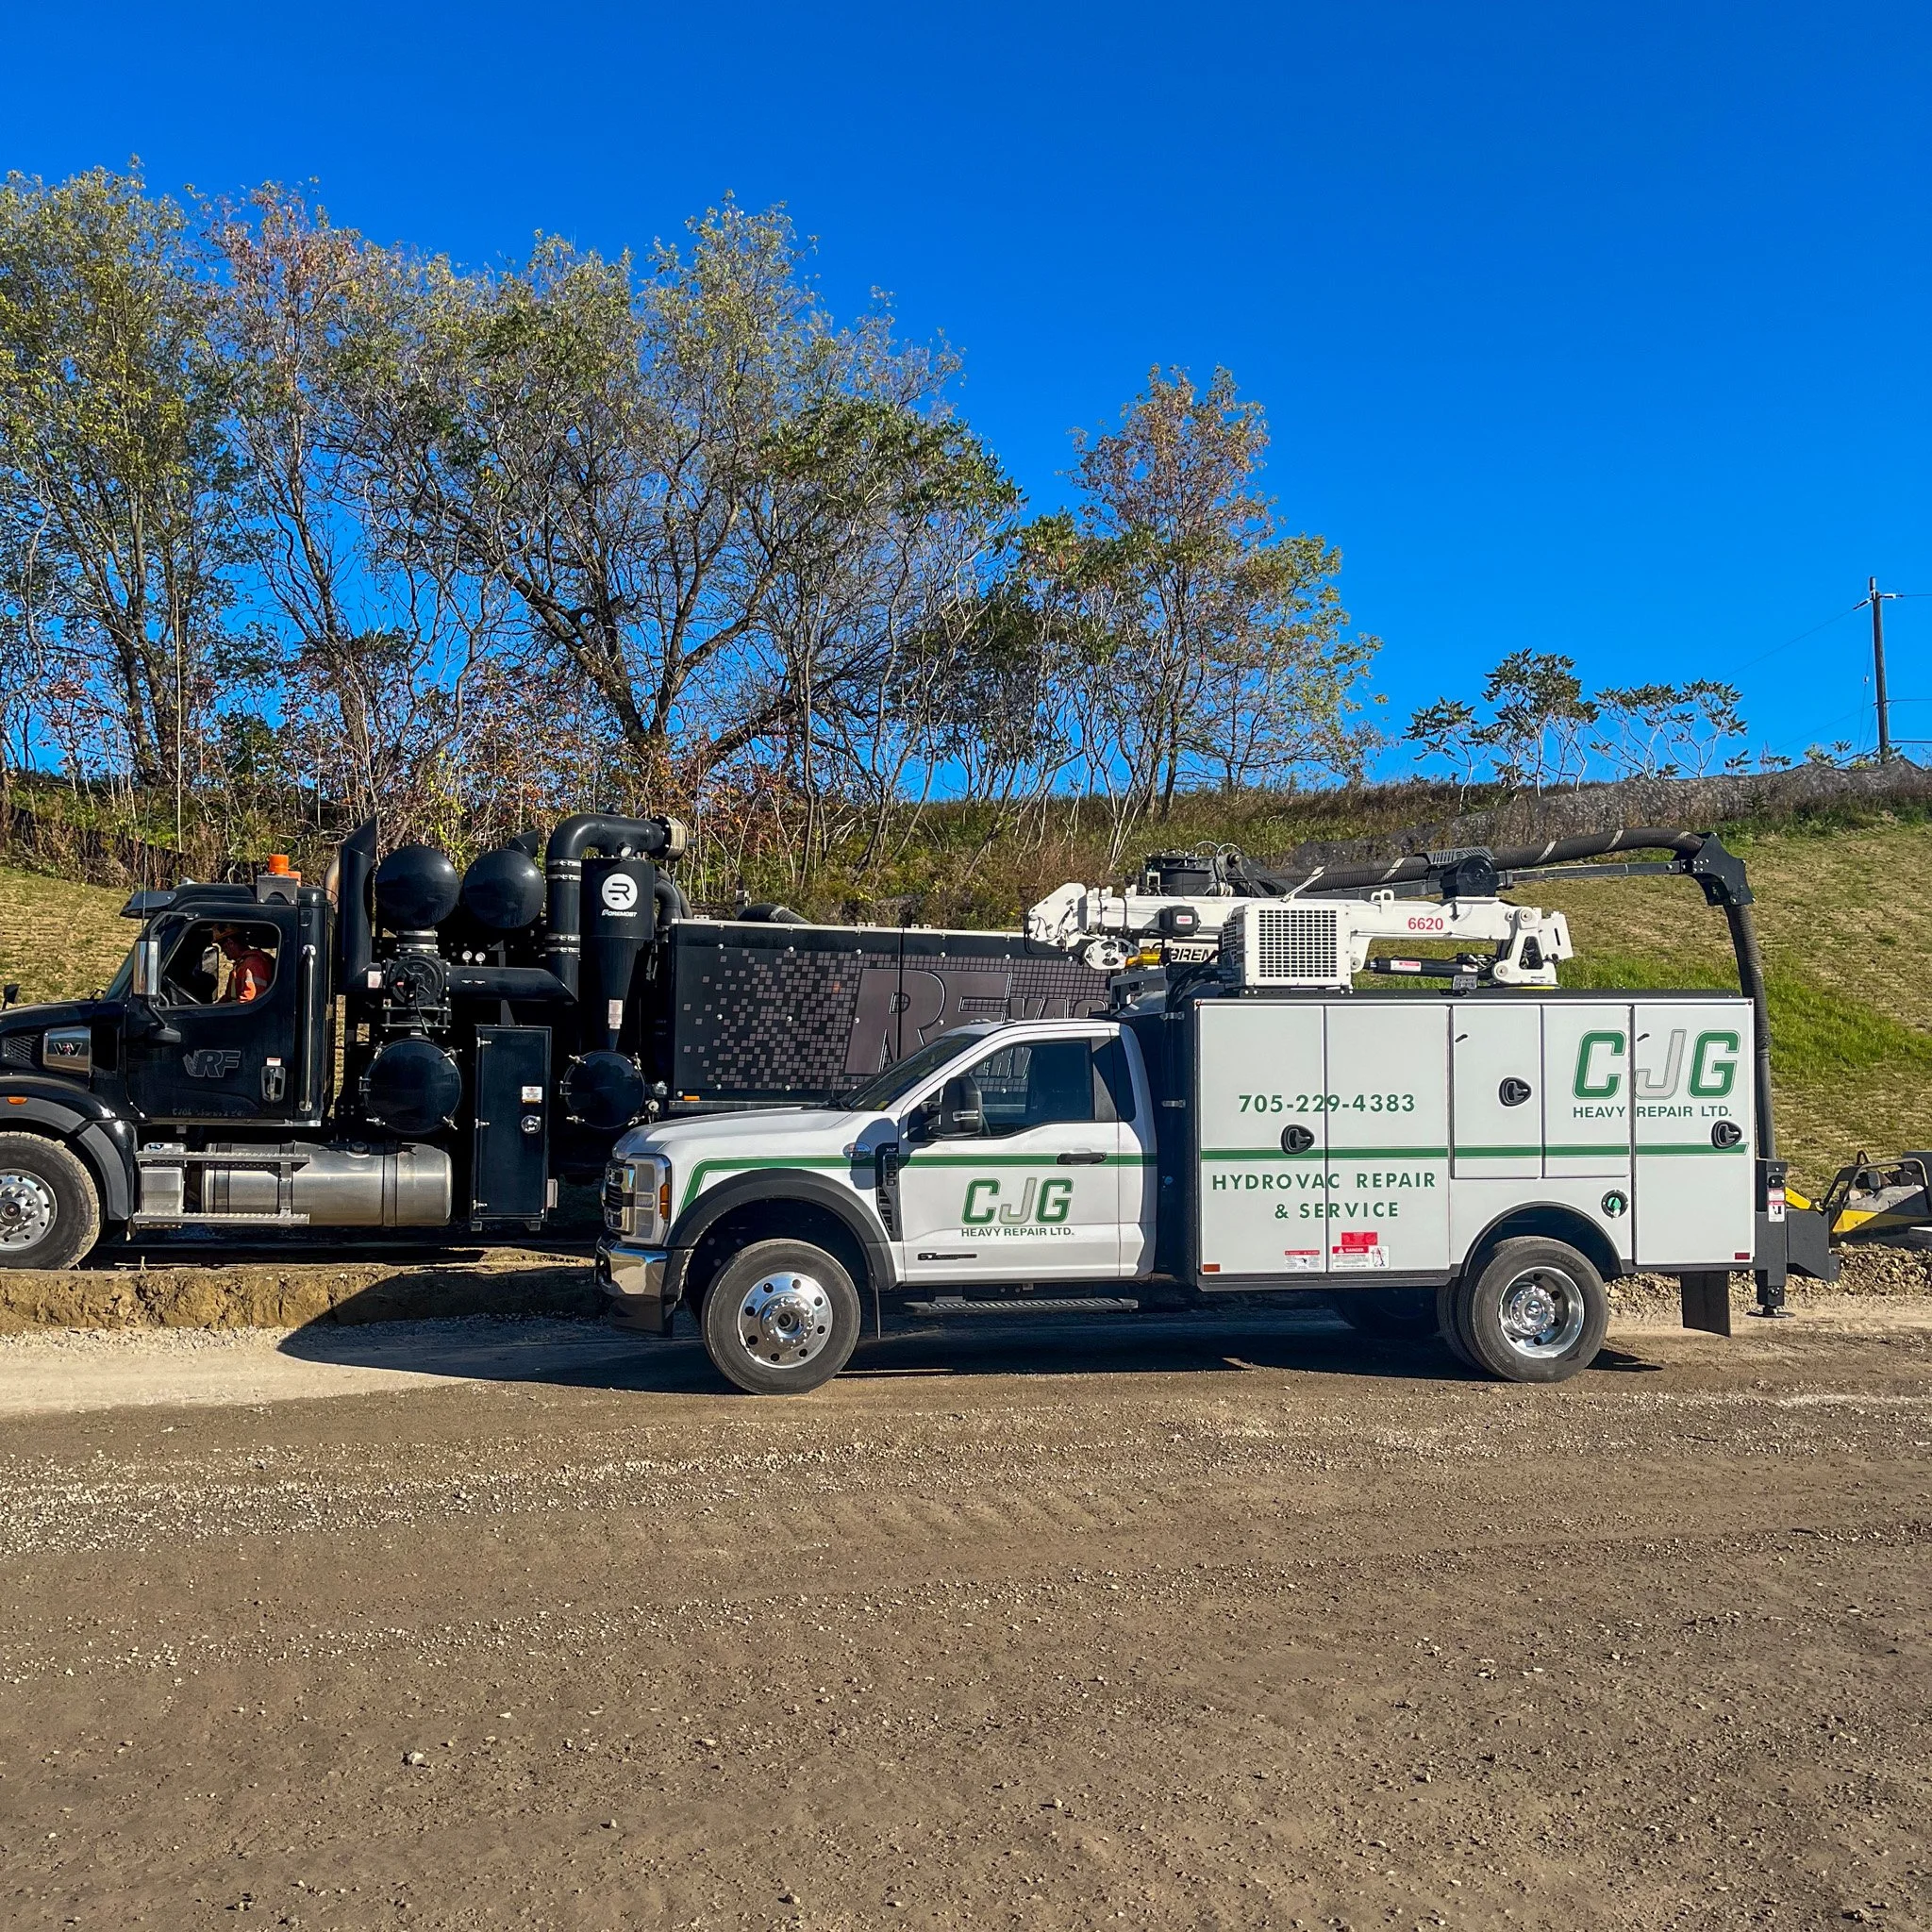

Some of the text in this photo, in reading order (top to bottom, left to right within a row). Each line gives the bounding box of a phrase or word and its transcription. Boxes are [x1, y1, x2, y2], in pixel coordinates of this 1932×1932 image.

[1407, 917, 1443, 930] 6620
[1573, 1027, 1740, 1100] CJG
[1239, 1094, 1416, 1113] 705-229-4383
[1573, 1106, 1732, 1118] HEAVY REPAIR LTD.
[1212, 1172, 1436, 1191] HYDROVAC REPAIR
[961, 1177, 1074, 1224] CJG
[1274, 1201, 1399, 1219] & SERVICE
[961, 1227, 1074, 1237] HEAVY REPAIR LTD.
